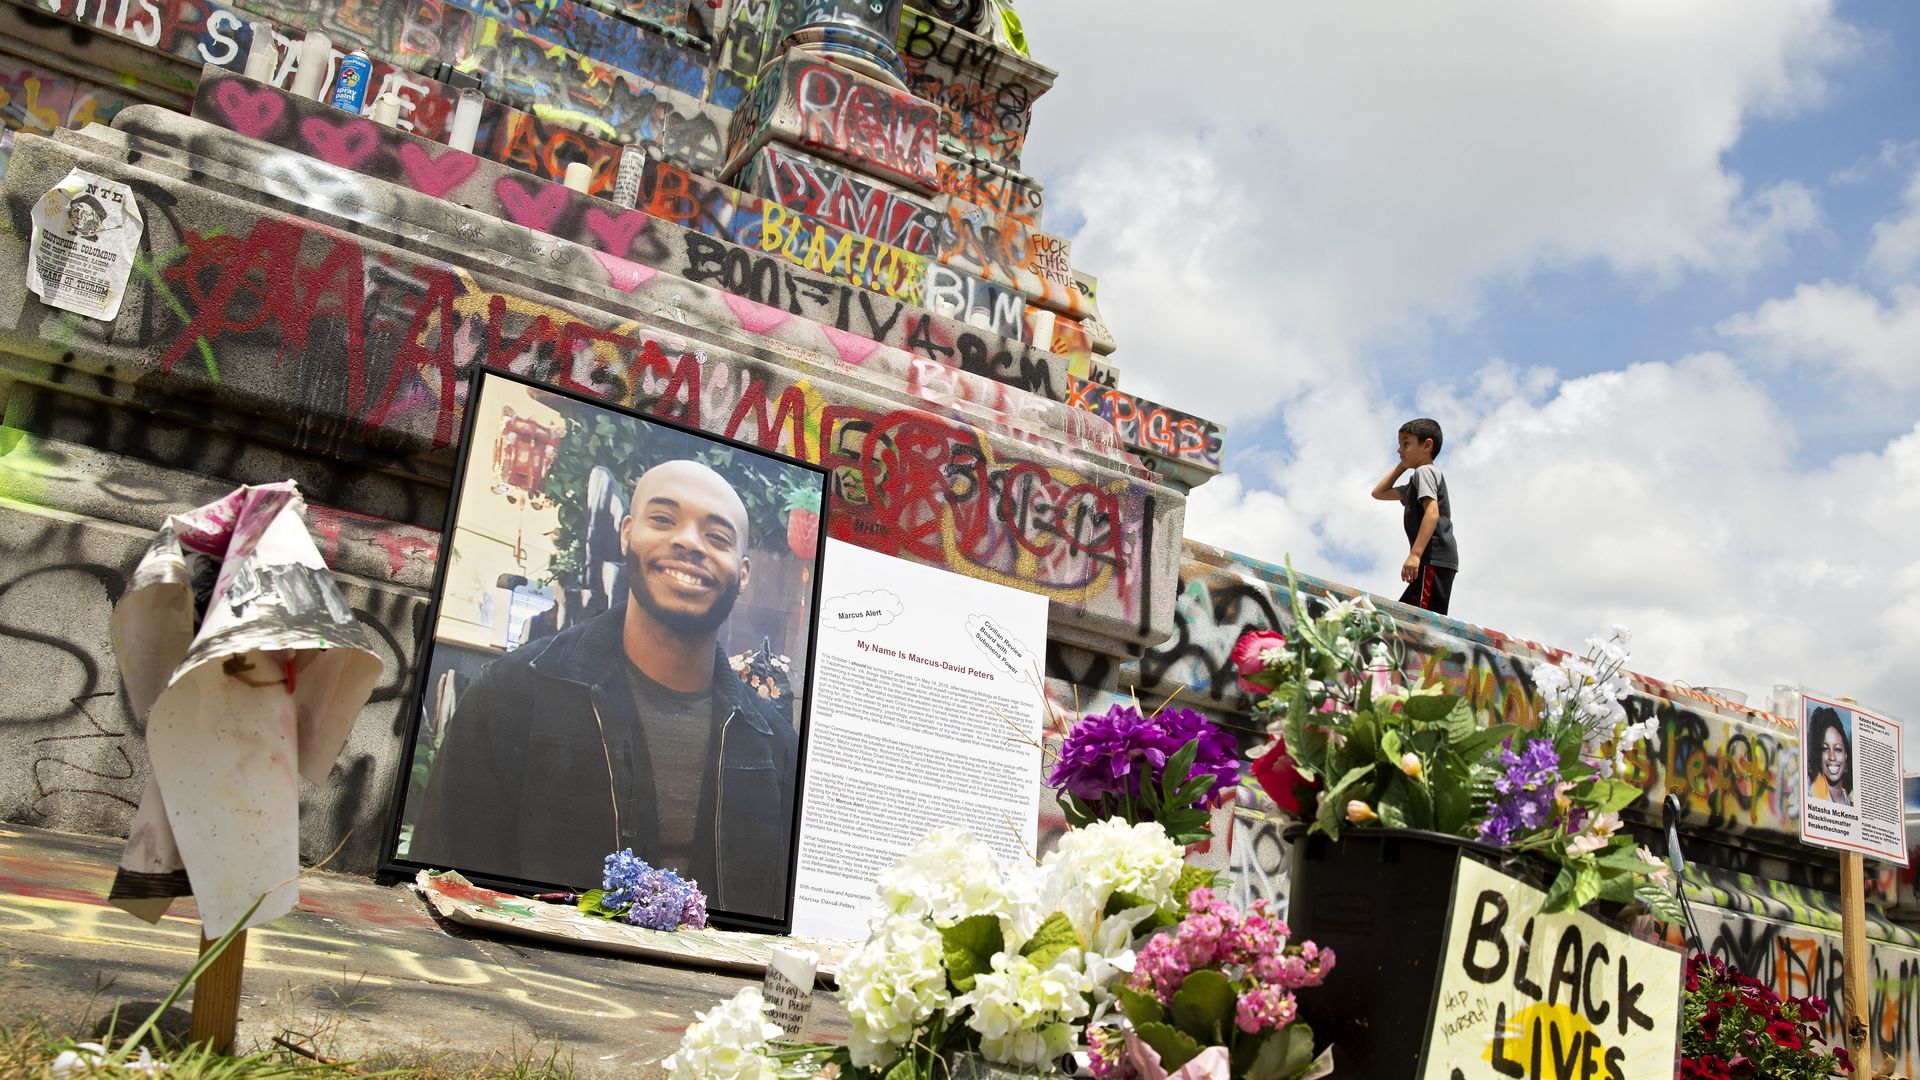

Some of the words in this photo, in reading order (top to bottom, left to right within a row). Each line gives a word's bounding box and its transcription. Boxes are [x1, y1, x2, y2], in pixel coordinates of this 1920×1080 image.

[904, 15, 998, 88] BLM
[335, 93, 355, 102] paint
[337, 87, 357, 96] spray
[81, 244, 117, 262] COLUMBUS
[762, 199, 900, 296] BLM!!!
[1032, 234, 1068, 257] FUCK
[1035, 252, 1069, 272] THIS
[64, 276, 74, 285] OF
[77, 280, 109, 296] TOURISM
[1027, 262, 1078, 289] STATUE
[925, 263, 1023, 342] BLM
[1102, 390, 1207, 455] PIGS
[838, 611, 864, 620] Marcus
[866, 609, 882, 618] Alert
[979, 626, 997, 644] Board
[996, 642, 1008, 654] with
[984, 620, 1004, 640] Civilian
[1003, 638, 1023, 658] Review
[857, 640, 870, 651] My
[872, 644, 896, 657] Name
[898, 650, 906, 660] Is
[908, 652, 966, 675] Marcus-David
[968, 667, 995, 681] Peters
[975, 632, 1002, 662] Subpoena
[1001, 658, 1018, 674] Power
[1808, 804, 1830, 814] Natasha
[1832, 809, 1858, 821] McKenna
[1808, 813, 1852, 828] #blacklivesmatter
[1808, 822, 1850, 836] #makethechange
[1491, 1002, 1625, 1080] LIVES
